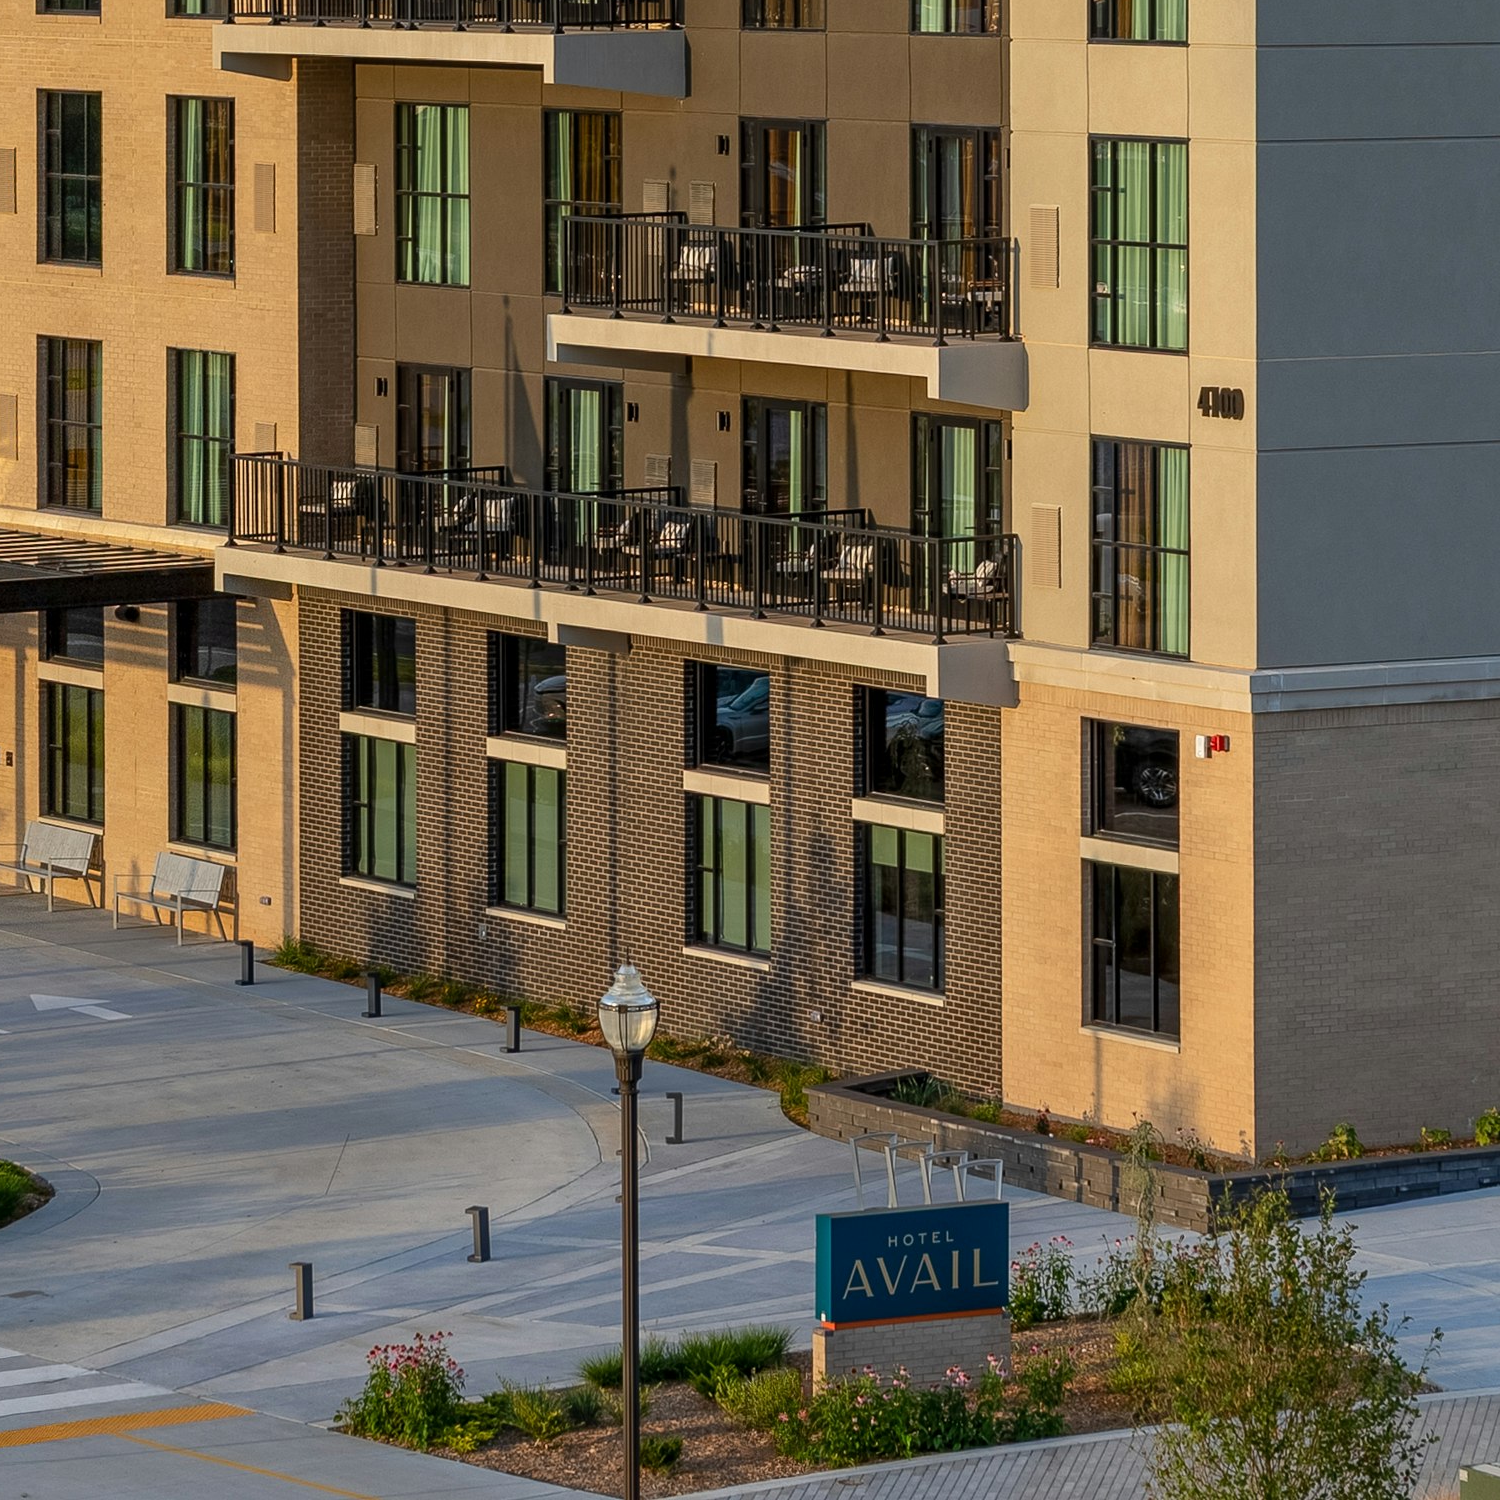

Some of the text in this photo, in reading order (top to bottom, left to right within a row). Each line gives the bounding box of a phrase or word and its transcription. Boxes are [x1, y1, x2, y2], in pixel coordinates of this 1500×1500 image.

[1197, 386, 1245, 421] 4100
[888, 1230, 954, 1247] HOTEL
[842, 1248, 999, 1300] AVAIL
